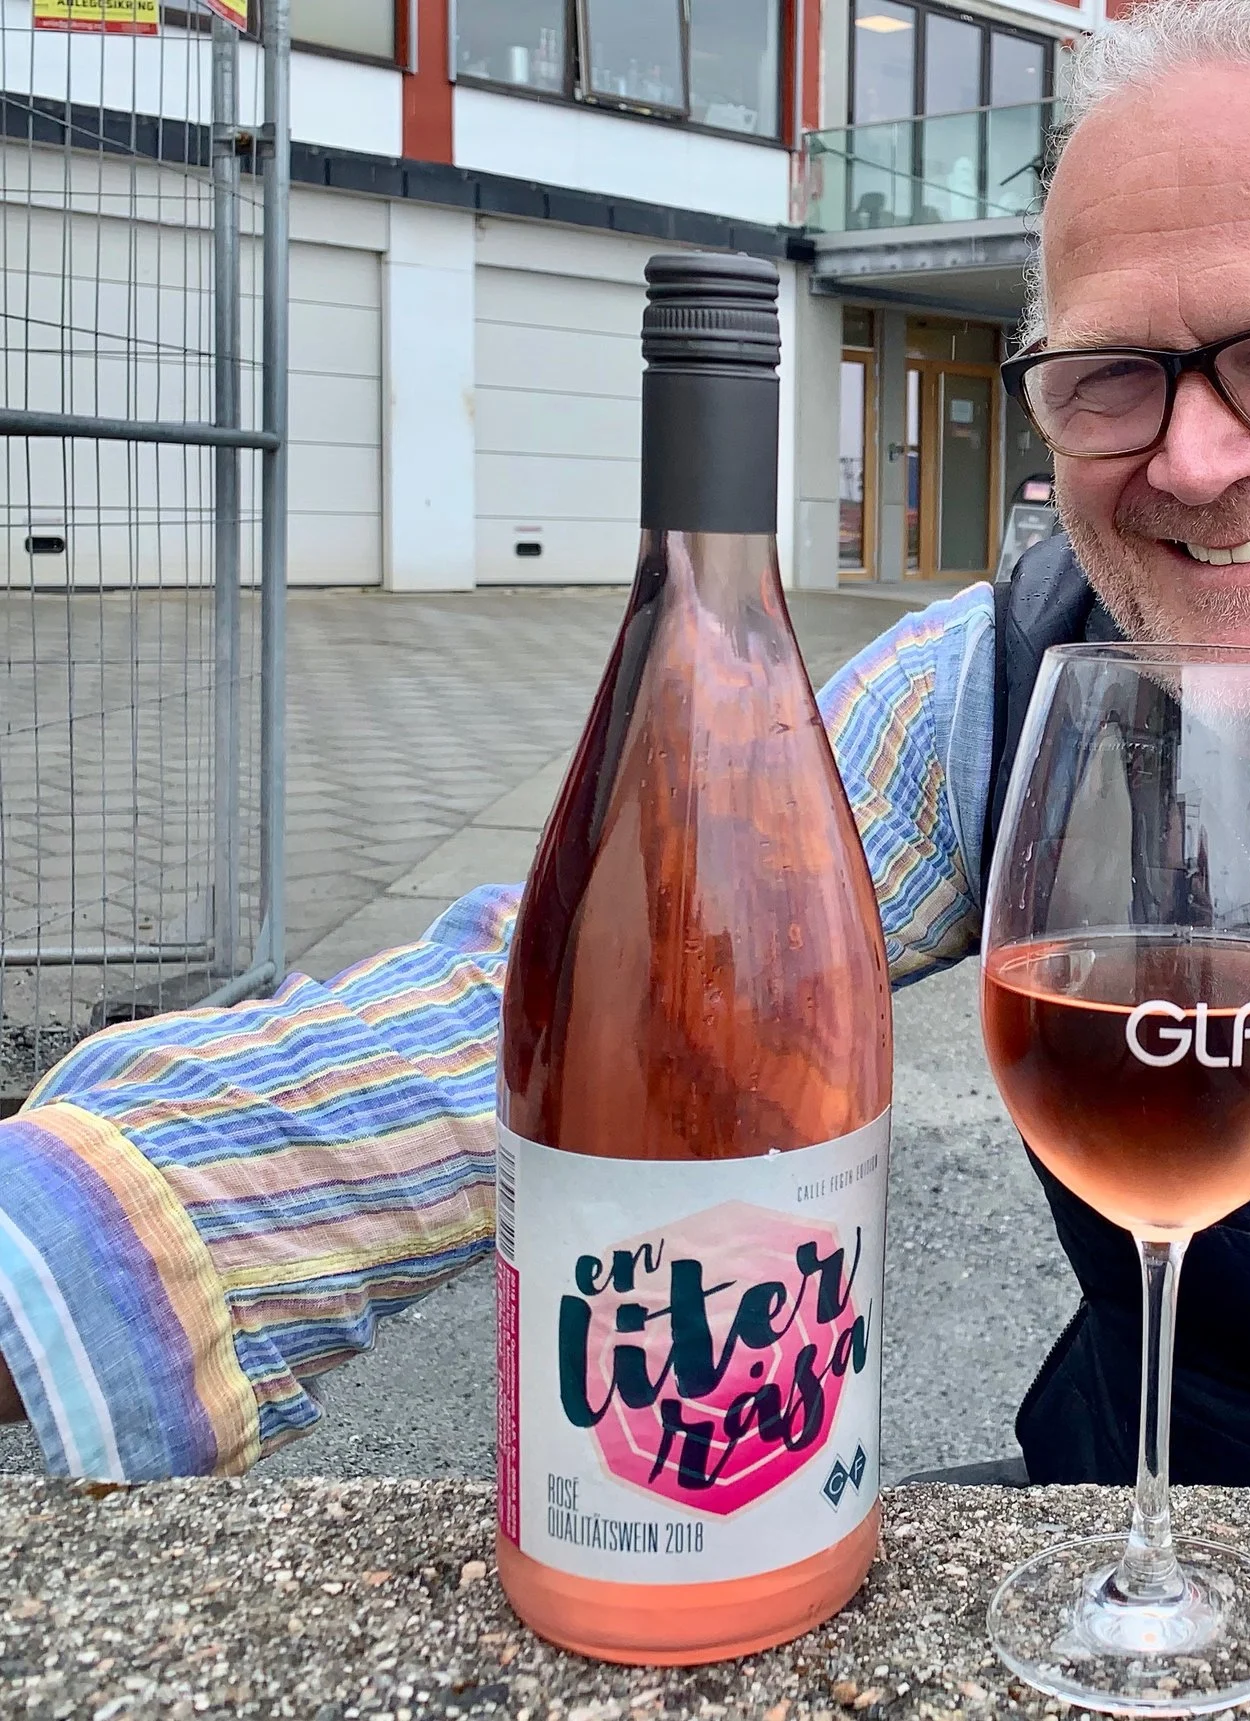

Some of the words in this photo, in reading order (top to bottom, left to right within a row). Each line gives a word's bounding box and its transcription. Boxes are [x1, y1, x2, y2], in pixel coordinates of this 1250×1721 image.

[797, 1179, 825, 1202] CALLE
[575, 1238, 664, 1296] en
[559, 1226, 861, 1428] liter
[548, 1473, 579, 1511] ROSÉ
[548, 1506, 658, 1553] QUALITÄTSWEIN
[665, 1521, 703, 1554] 2018
